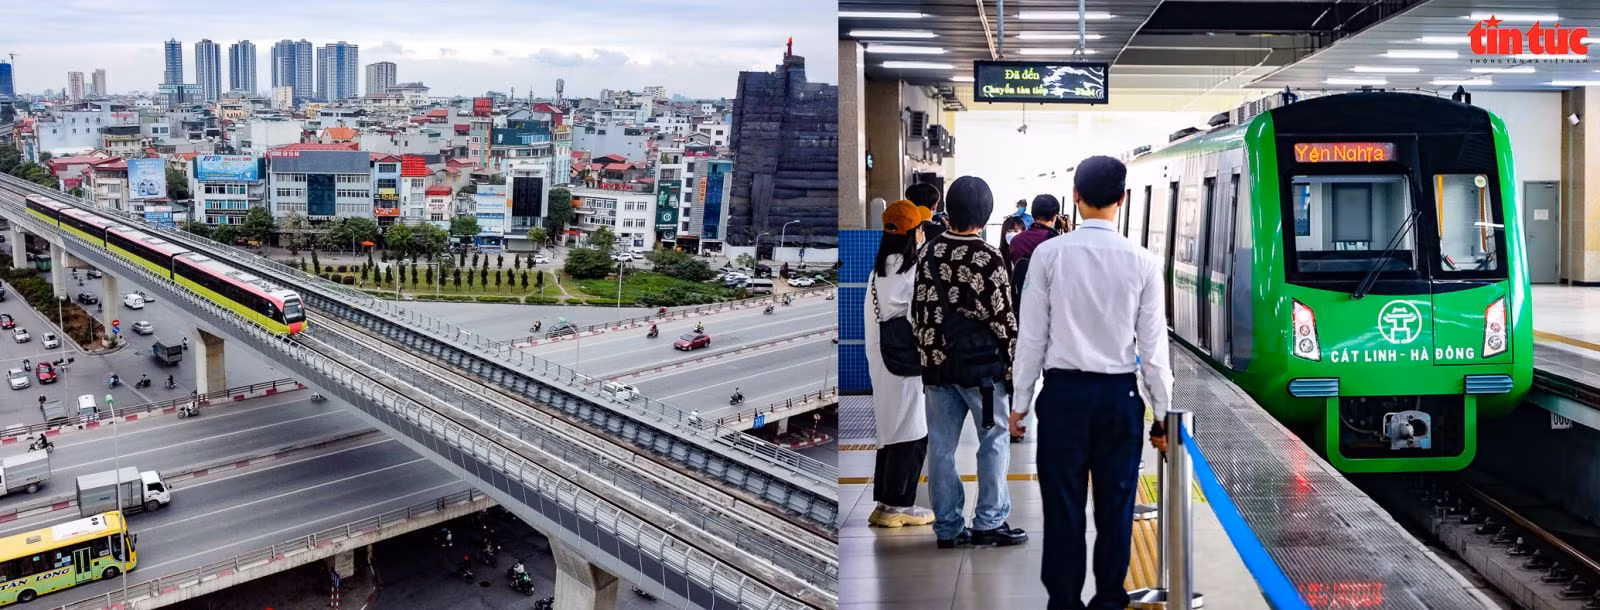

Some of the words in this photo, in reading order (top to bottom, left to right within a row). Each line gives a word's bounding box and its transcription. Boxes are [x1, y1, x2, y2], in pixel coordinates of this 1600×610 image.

[1004, 69, 1020, 80] Đã
[1295, 145, 1330, 162] Yên
[1334, 145, 1384, 162] Nghĩa
[1331, 348, 1360, 363] CÁT
[1364, 349, 1397, 362] LINH
[1410, 346, 1429, 361] HÀ
[1435, 344, 1475, 360] ĐÔNG
[36, 567, 71, 582] LONG
